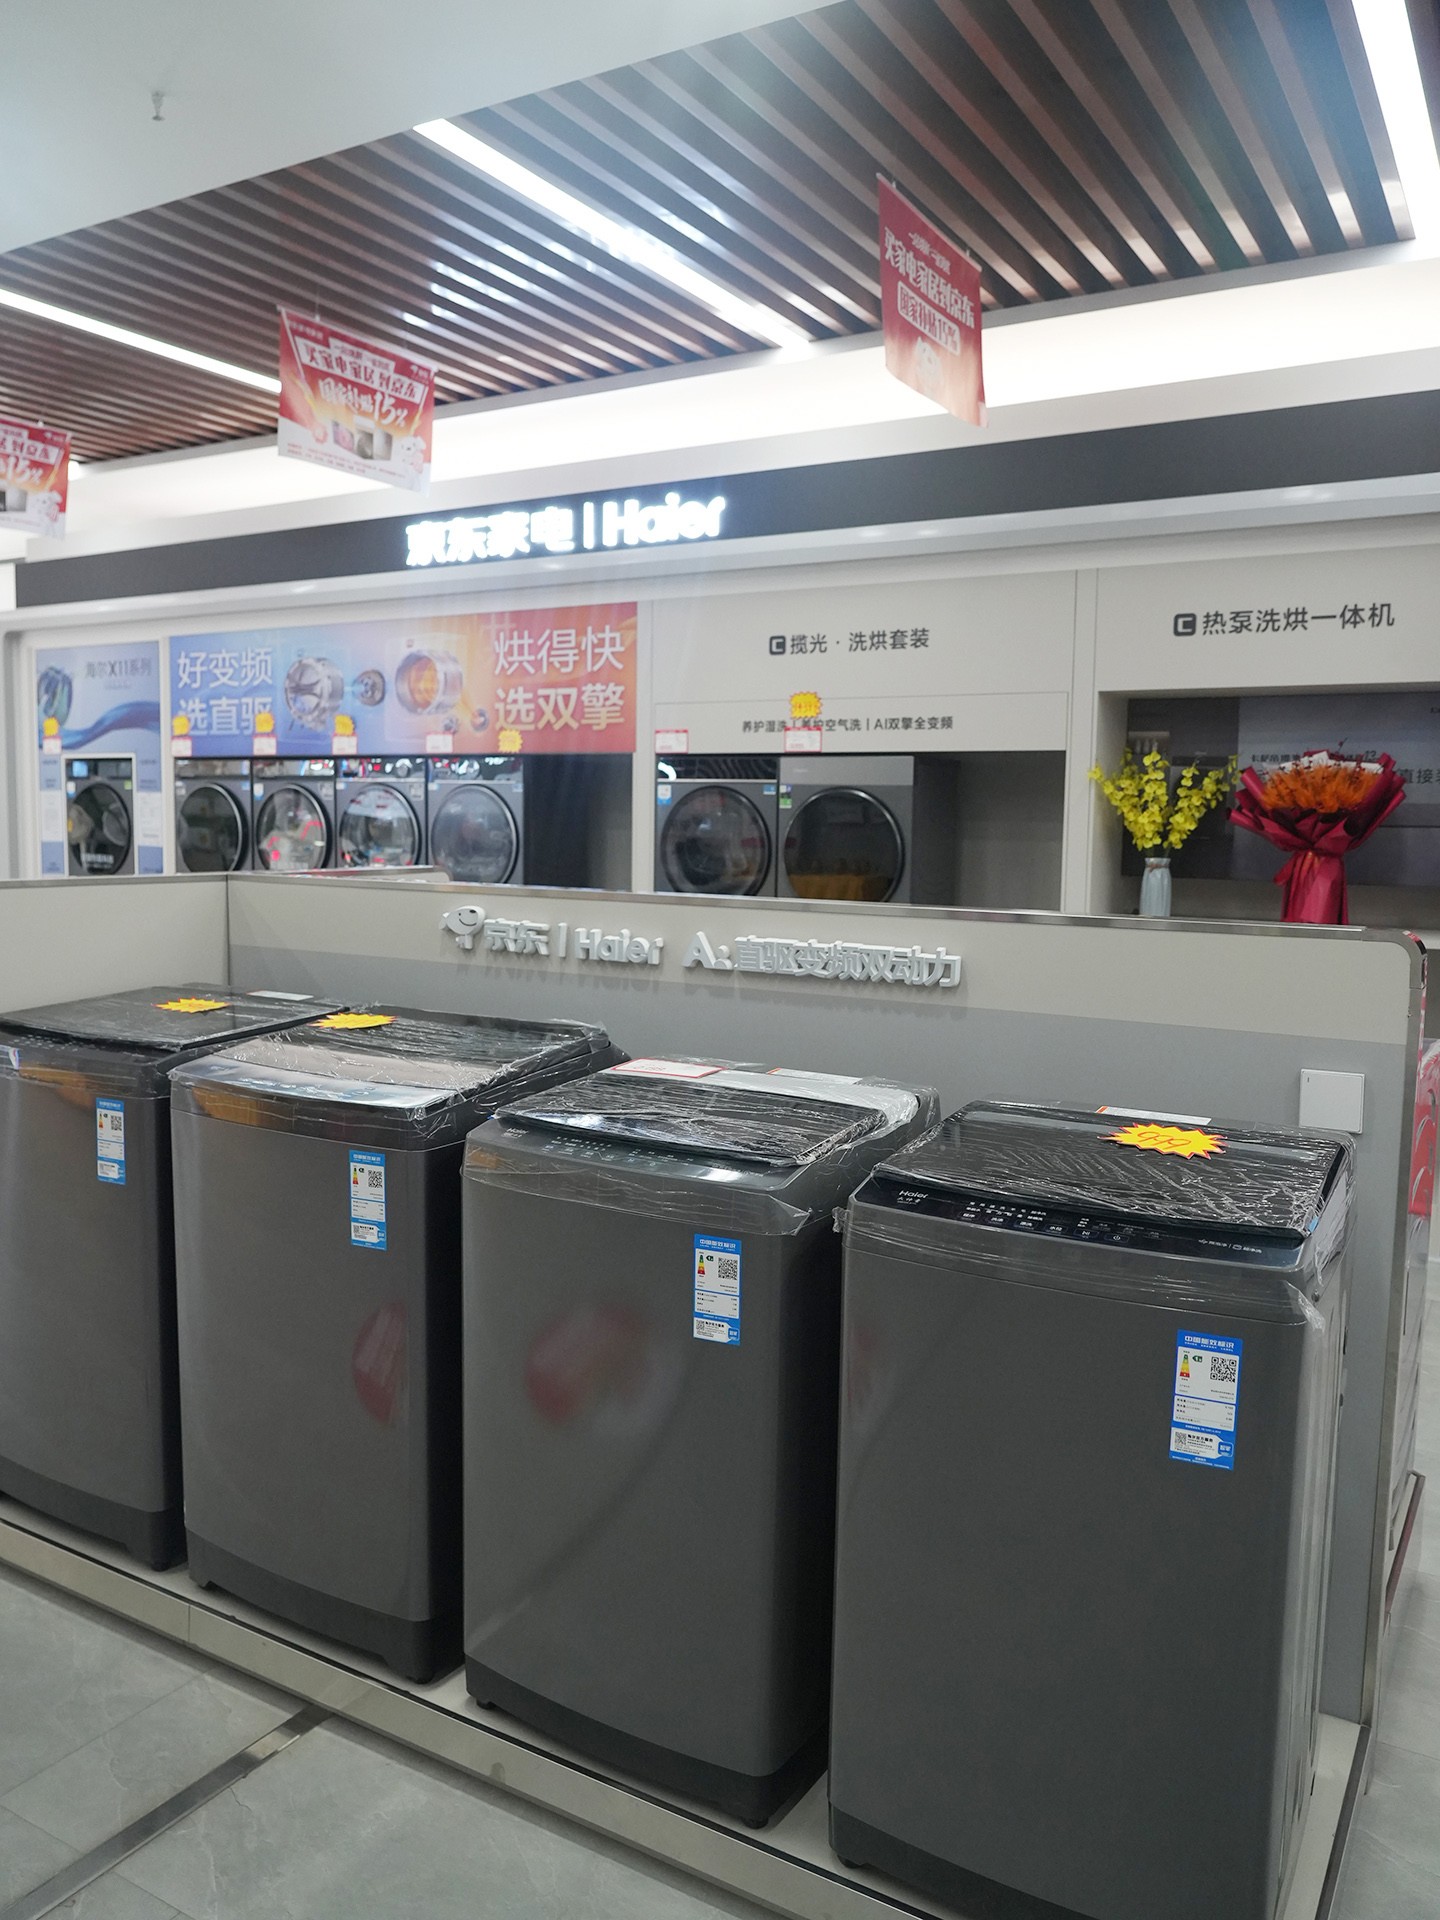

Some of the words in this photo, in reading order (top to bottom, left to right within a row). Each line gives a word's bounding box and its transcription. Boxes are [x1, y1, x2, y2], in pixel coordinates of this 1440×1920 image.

[404, 506, 576, 567] 京东家电
[601, 491, 726, 547] Haier
[1202, 602, 1395, 636] 热泵洗烘一体机
[494, 624, 626, 676] 烘得快
[847, 627, 930, 653] 洗烘套装
[177, 646, 273, 689] 好变频
[494, 681, 626, 732] 选双擎
[874, 716, 954, 731] AI双擎全变频
[484, 918, 549, 956] 京东
[574, 926, 665, 966] Haier
[1137, 1131, 1192, 1150] 999
[898, 1189, 929, 1199] Haier
